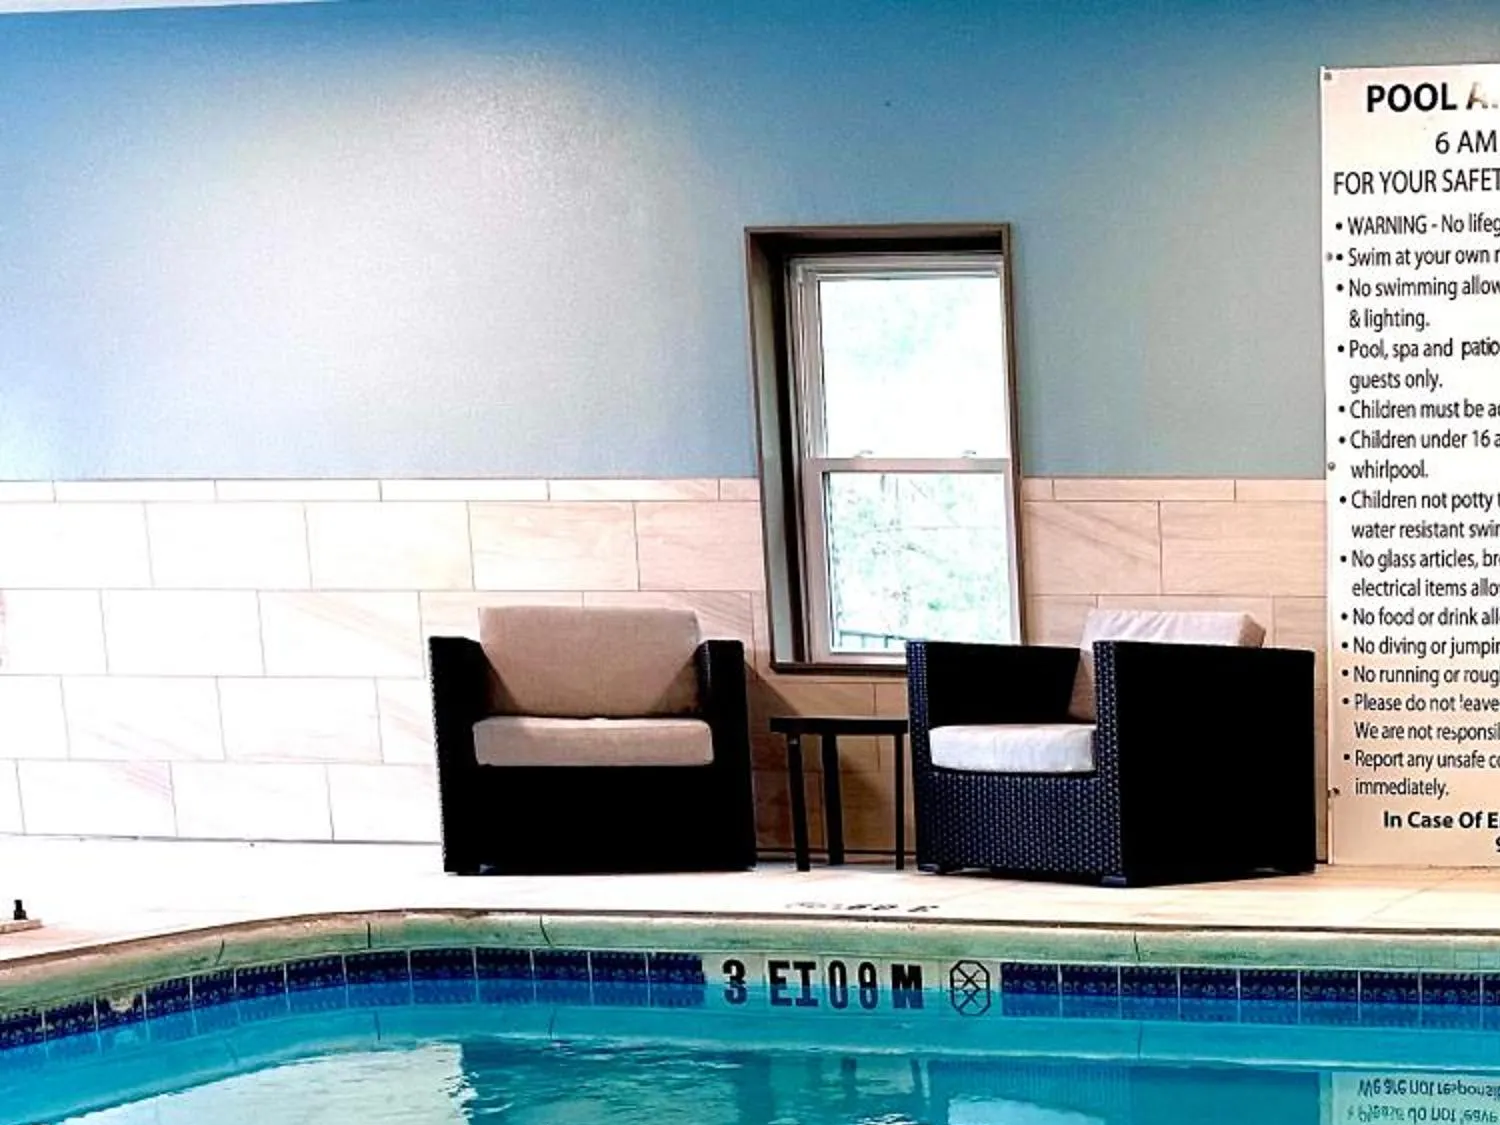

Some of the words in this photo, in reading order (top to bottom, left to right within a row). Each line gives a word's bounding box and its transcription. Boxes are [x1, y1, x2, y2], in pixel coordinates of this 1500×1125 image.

[1367, 82, 1458, 113] POOL
[1435, 131, 1450, 154] 6
[1457, 130, 1497, 154] AM
[1334, 171, 1374, 195] FOR
[1379, 169, 1437, 194] YOUR
[1347, 214, 1427, 236] WARNING
[1442, 214, 1464, 233] No
[1348, 247, 1391, 267] Swim
[1395, 248, 1411, 266] at
[1414, 250, 1451, 270] your
[1455, 249, 1490, 264] own
[1349, 278, 1372, 297] No
[1375, 276, 1458, 301] swimming
[1349, 309, 1360, 328] &
[1364, 308, 1430, 333] lighting.
[1349, 338, 1388, 360] Pool,
[1392, 343, 1419, 362] spa
[1423, 337, 1453, 357] and
[1461, 339, 1500, 360] patio
[1349, 372, 1401, 394] guests
[1404, 368, 1443, 393] only.
[1350, 400, 1416, 419] Children
[1420, 402, 1460, 418] must
[1464, 398, 1484, 418] be
[1350, 429, 1416, 449] Children
[1421, 428, 1468, 448] under
[1472, 429, 1491, 448] 16
[1350, 459, 1428, 483] whirlpool.
[1351, 489, 1417, 509] Children
[1421, 492, 1447, 509] not
[1452, 492, 1494, 513] potty
[1352, 522, 1396, 539] water
[1400, 520, 1465, 538] resistant
[1352, 550, 1374, 568] No
[1377, 548, 1416, 573] glass
[1420, 548, 1478, 569] articles,
[1352, 578, 1420, 597] electrical
[1425, 579, 1467, 597] items
[1353, 608, 1375, 626] No
[1378, 606, 1414, 626] food
[1418, 612, 1435, 626] or
[1438, 606, 1478, 626] drink
[1353, 636, 1375, 654] No
[1378, 635, 1426, 659] diving
[1430, 641, 1447, 654] or
[1354, 665, 1376, 683] No
[1379, 665, 1440, 688] running
[1443, 669, 1460, 683] or
[1354, 692, 1402, 711] Please
[1405, 694, 1426, 712] do
[1430, 696, 1456, 712] not
[1354, 721, 1379, 739] We
[1381, 725, 1404, 740] are
[1407, 724, 1433, 741] not
[1355, 749, 1404, 772] Report
[1407, 754, 1434, 773] any
[1437, 750, 1486, 768] unsafe
[1355, 777, 1450, 800] immediately.
[1384, 810, 1402, 829] In
[1407, 811, 1454, 828] Case
[1458, 810, 1484, 829] Of
